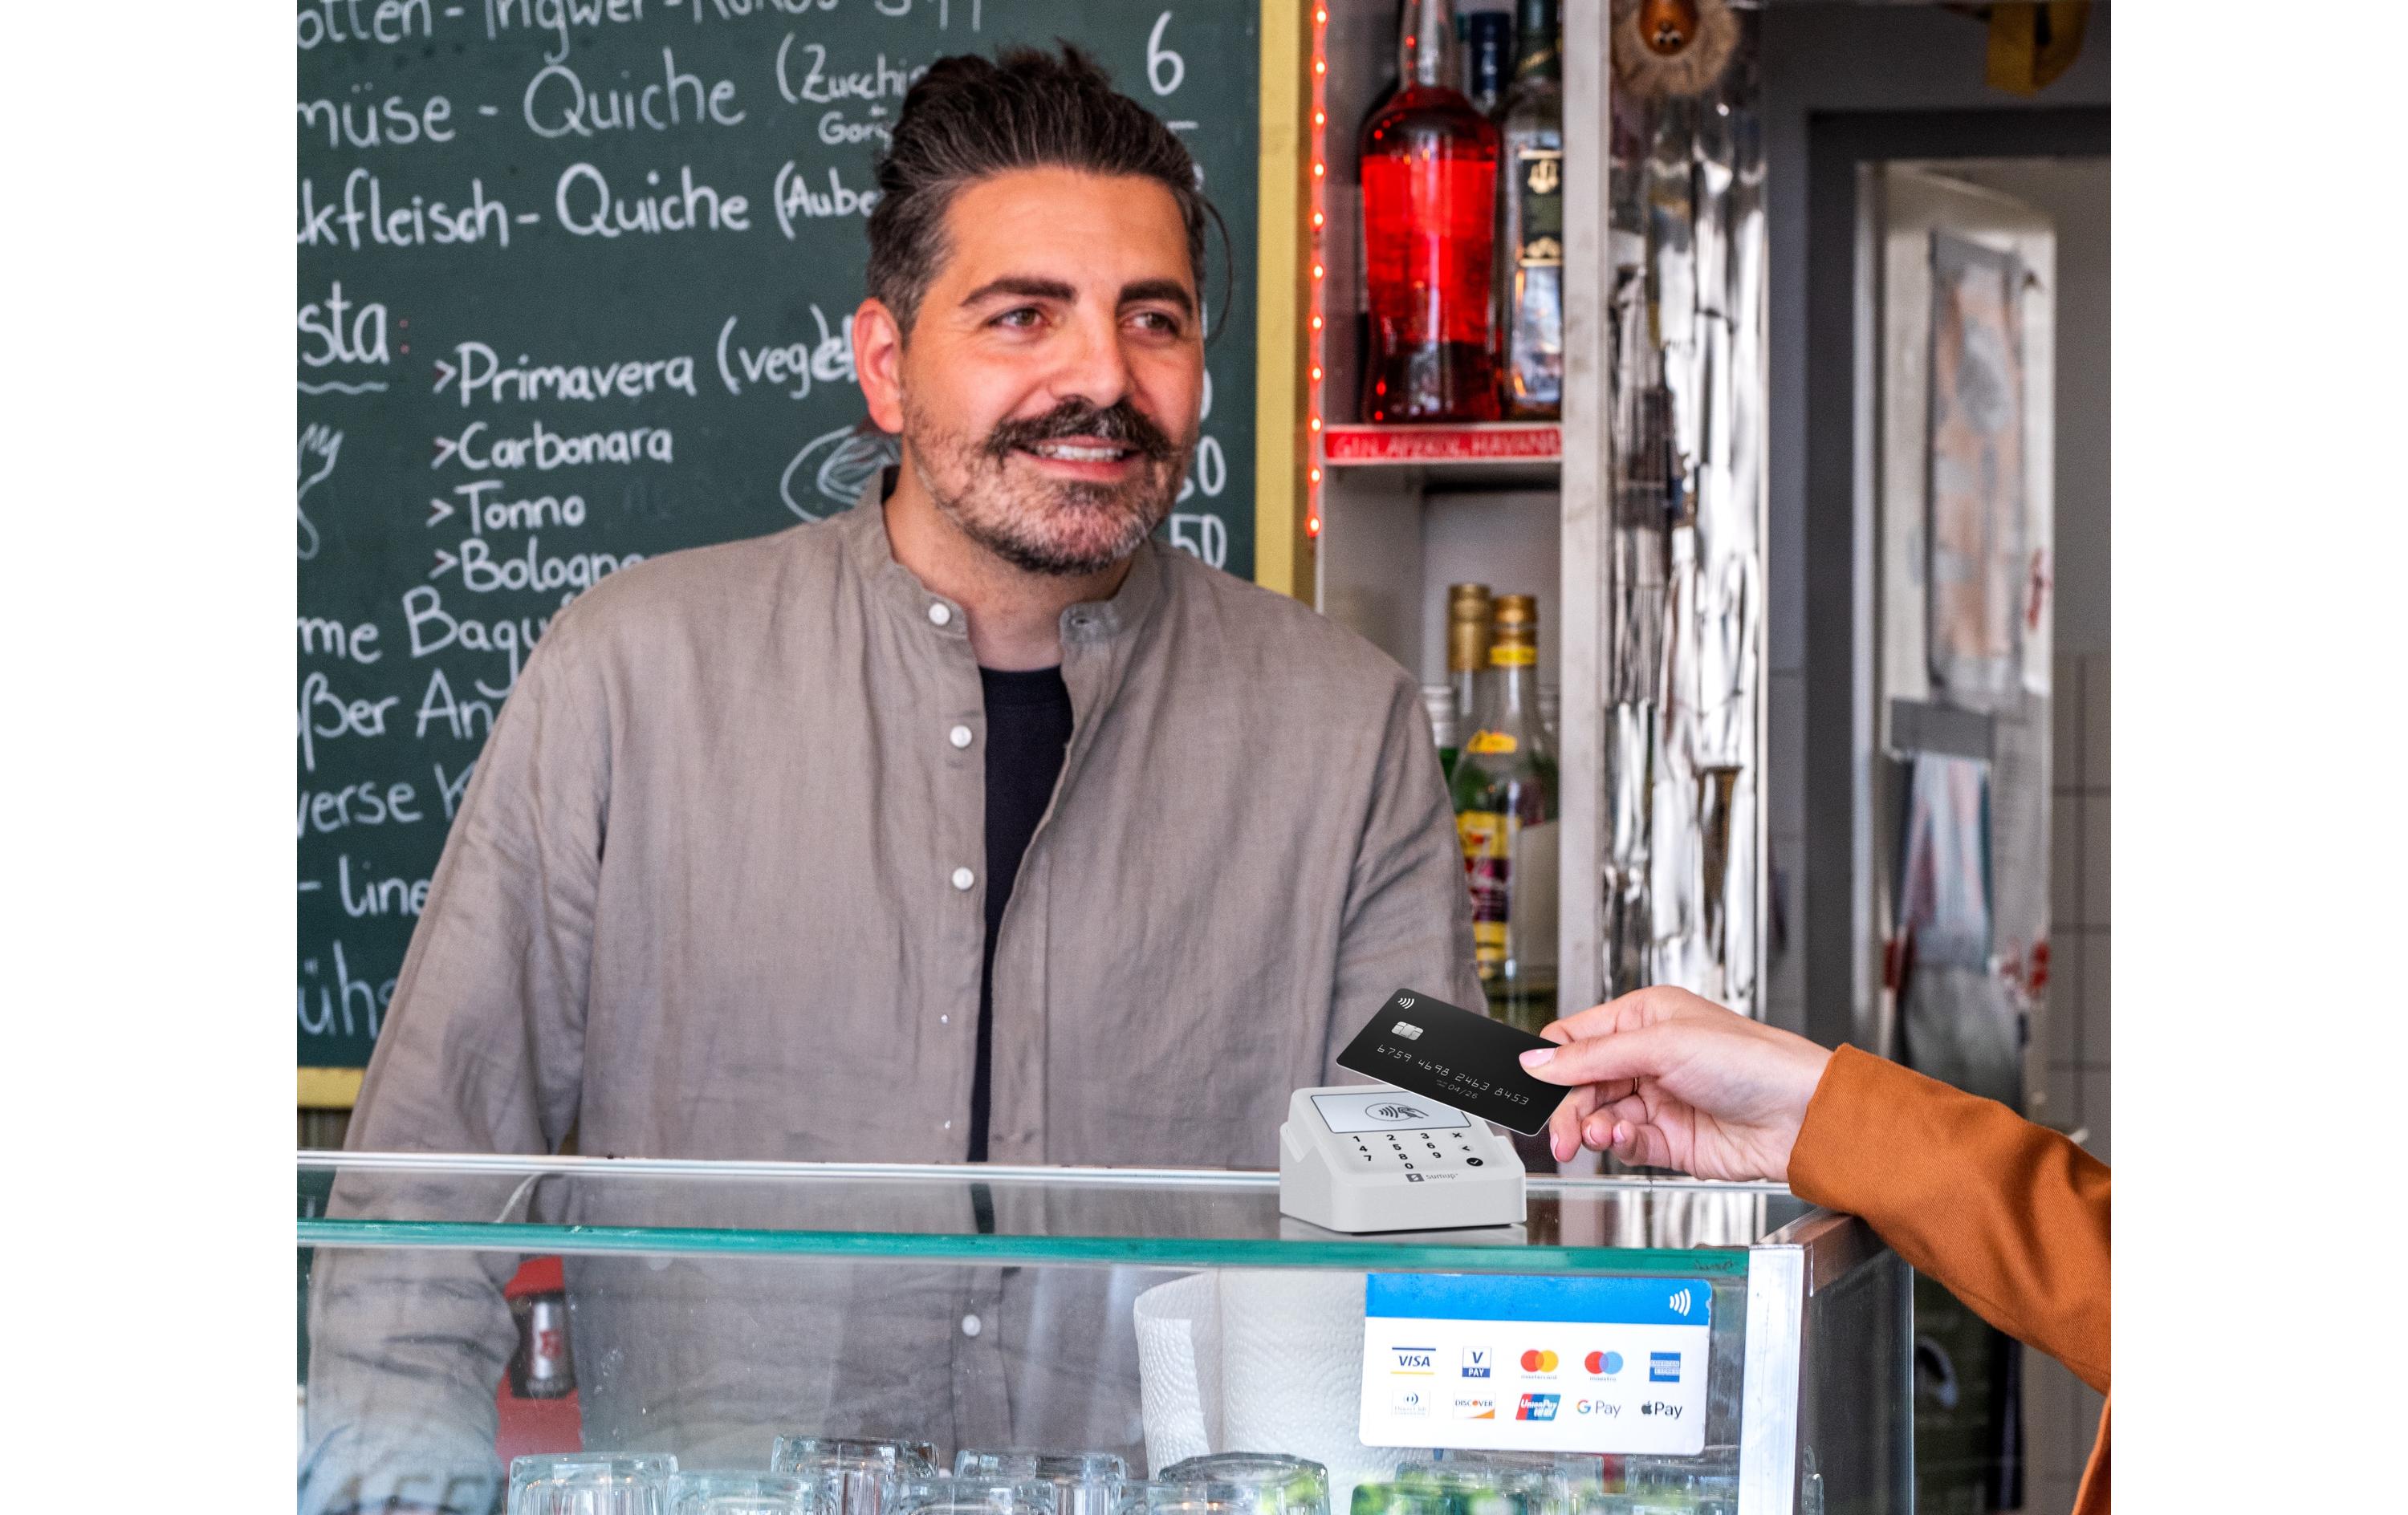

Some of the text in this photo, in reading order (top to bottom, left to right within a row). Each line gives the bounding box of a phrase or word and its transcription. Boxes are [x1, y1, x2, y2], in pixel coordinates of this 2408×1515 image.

[1146, 10, 1185, 95] 6
[523, 45, 748, 138] Quiche
[556, 162, 751, 238] Quiche
[458, 420, 674, 470] Carbonara
[454, 480, 587, 535] Tonno
[1377, 1044, 1412, 1062] 6759
[1418, 1058, 1450, 1076] 4698
[1454, 1072, 1491, 1091] 2463
[1494, 1086, 1530, 1106] 8453
[1399, 1355, 1431, 1367] VISA
[1467, 1367, 1484, 1378] PAY
[1471, 1351, 1483, 1364] V
[1454, 1399, 1494, 1407] DISCOVER
[1595, 1400, 1622, 1419] Pay
[1654, 1401, 1683, 1420] Pay
